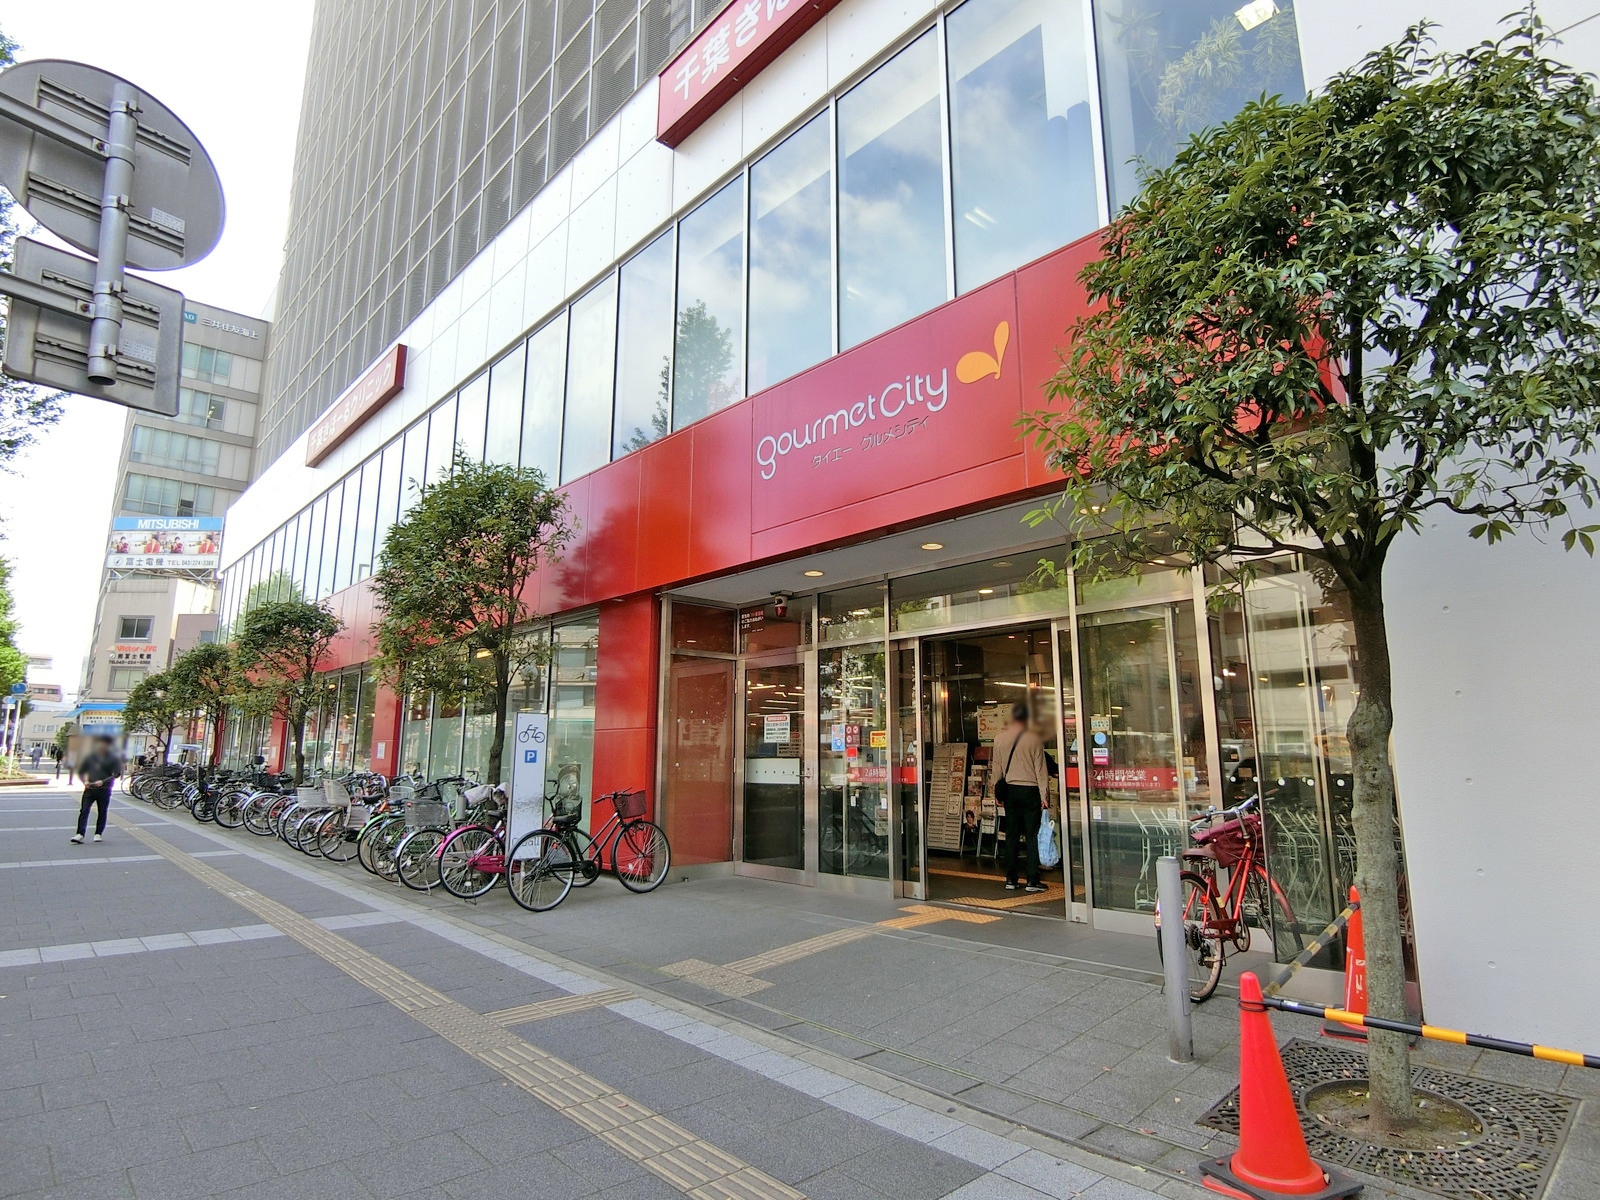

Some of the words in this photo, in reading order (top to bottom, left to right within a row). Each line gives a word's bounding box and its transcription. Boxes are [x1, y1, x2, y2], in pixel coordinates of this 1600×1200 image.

[137, 519, 199, 529] MITSUBISHI
[1093, 769, 1147, 781] 24時間営業
